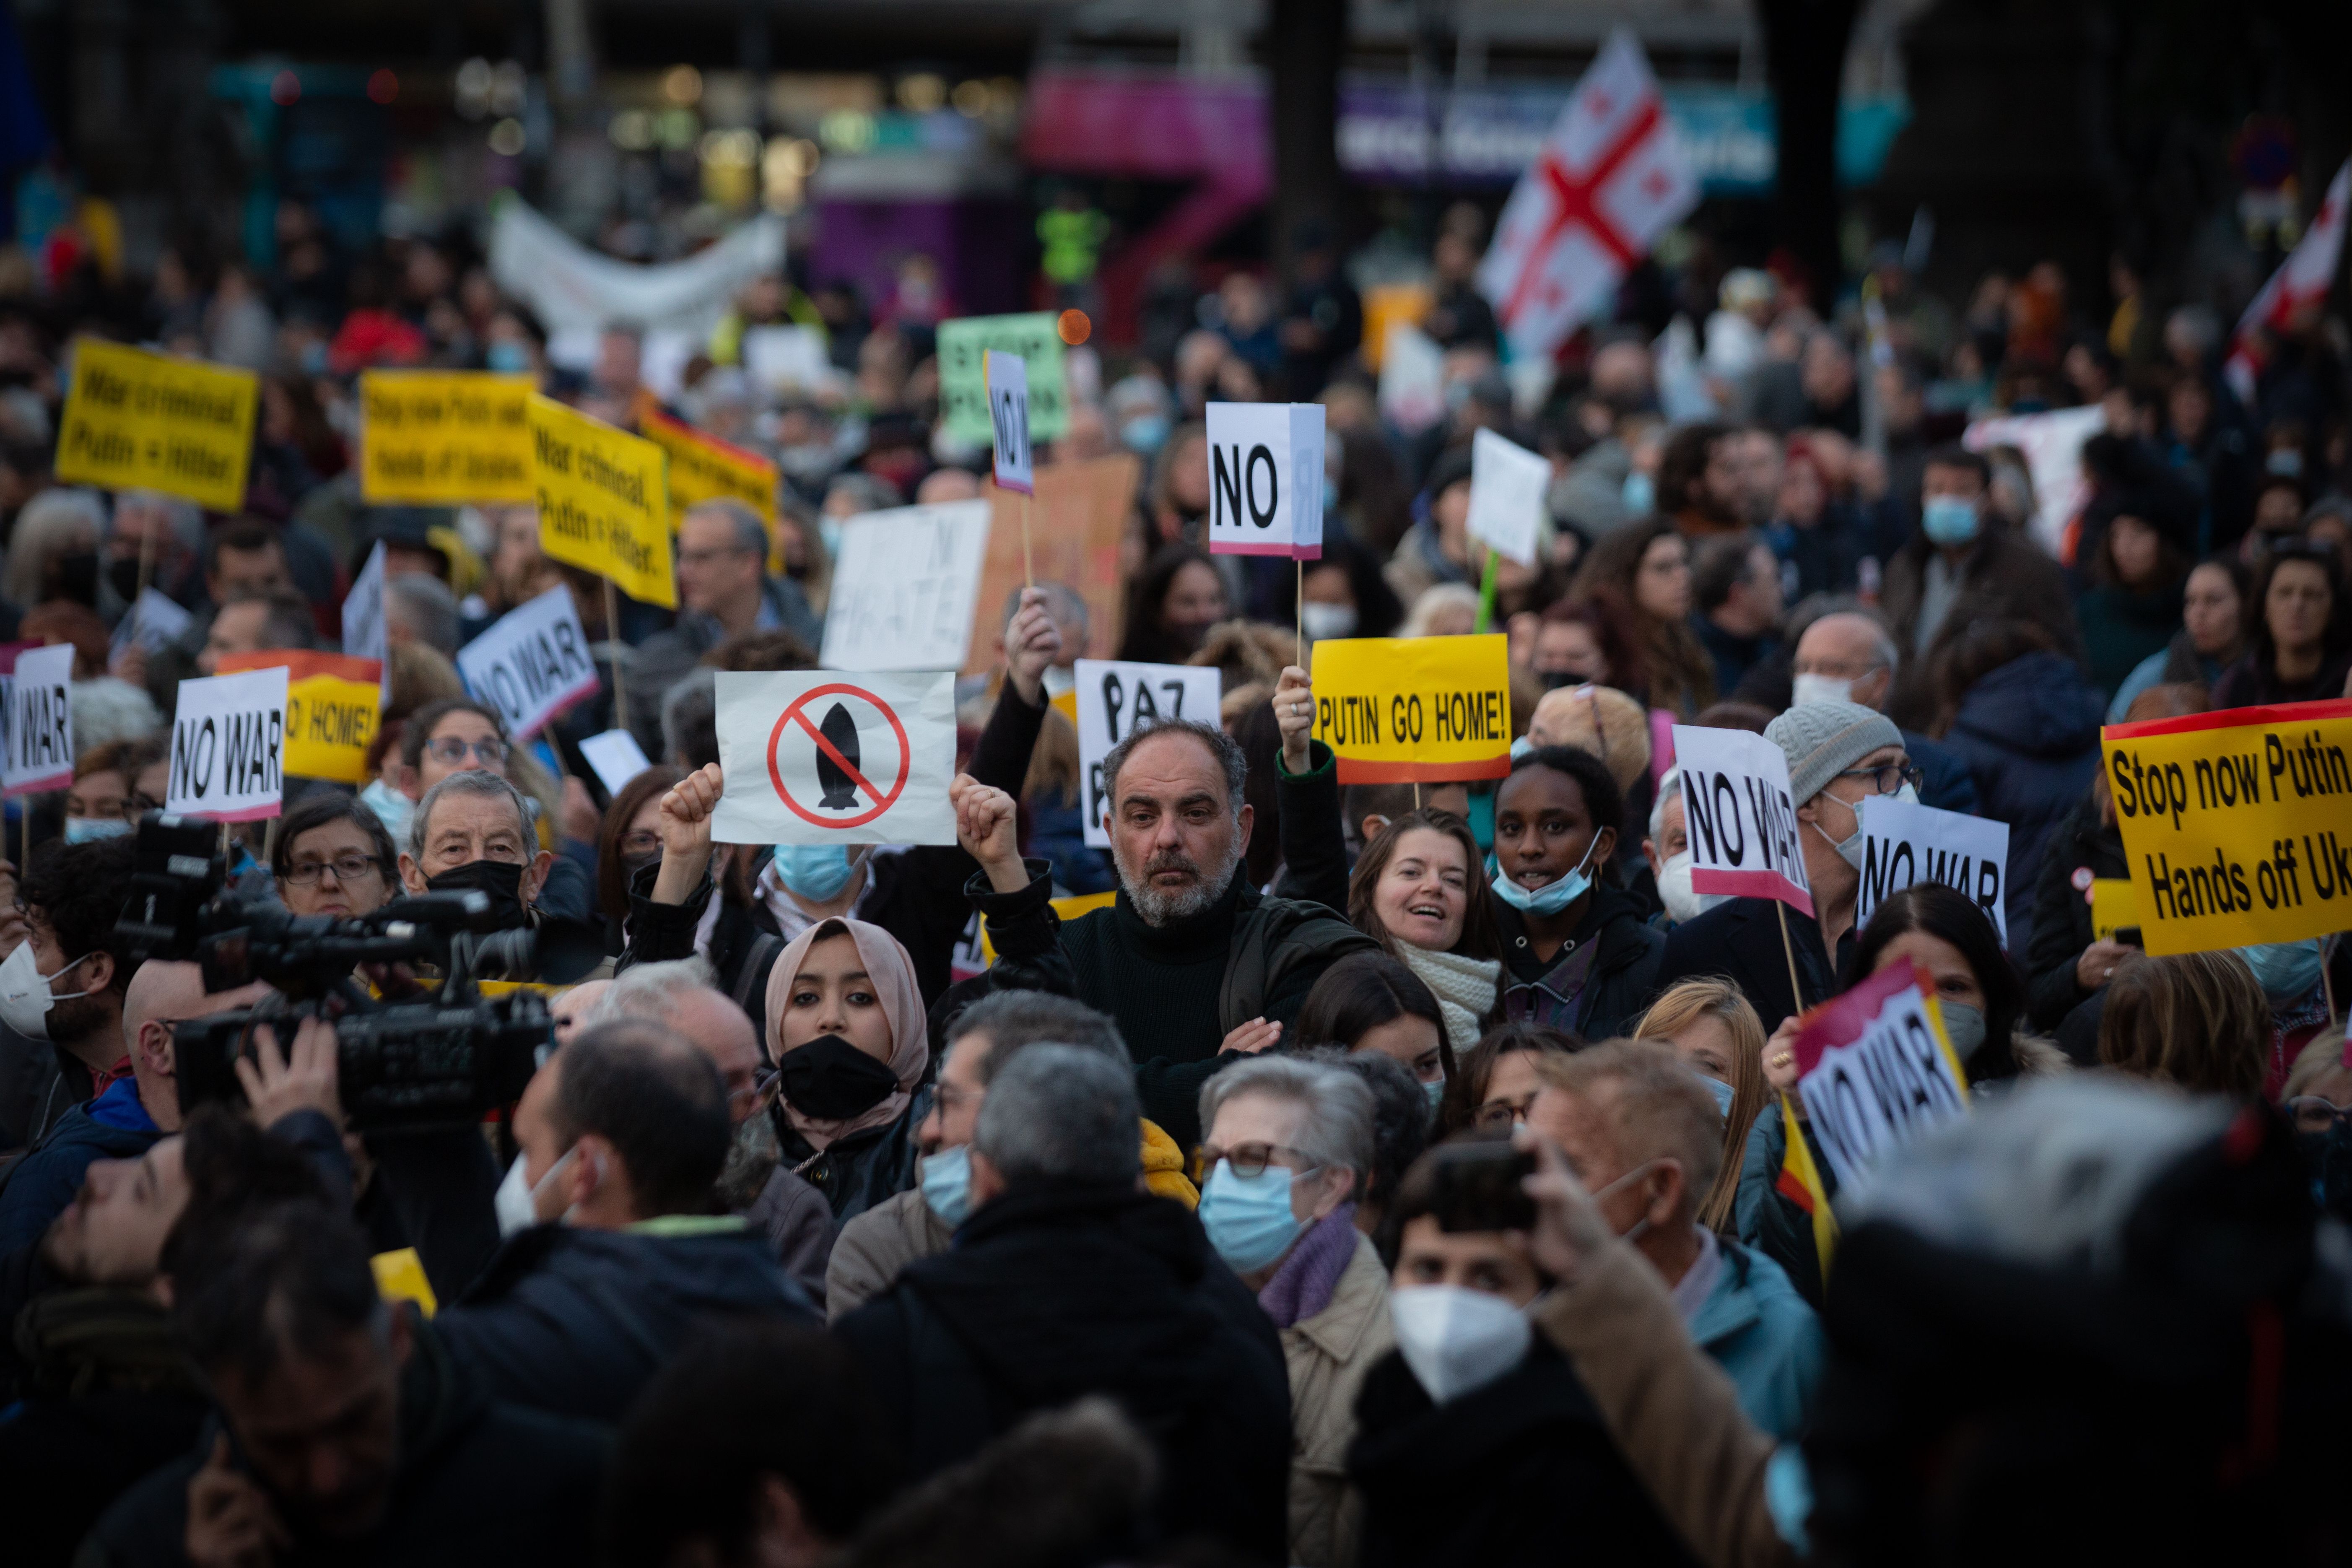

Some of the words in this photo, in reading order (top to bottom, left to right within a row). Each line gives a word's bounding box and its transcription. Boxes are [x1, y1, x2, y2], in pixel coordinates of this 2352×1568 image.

[536, 424, 572, 475] War
[1213, 443, 1277, 528] NO
[537, 485, 589, 543] Putin
[508, 618, 587, 705] WAR
[21, 683, 70, 768] WAR
[169, 715, 215, 800] NO
[223, 708, 281, 795] WAR
[286, 697, 300, 740] O
[309, 699, 372, 749] HOME!
[1320, 695, 1380, 745] PUTIN
[1392, 694, 1423, 743] GO
[1436, 690, 1505, 741] HOME!
[2112, 749, 2187, 831] Stop
[2193, 753, 2261, 810] now
[2265, 729, 2352, 801] Putin
[1682, 770, 1744, 867] NO
[1744, 775, 1807, 890] WAR
[1862, 835, 1914, 916] NO
[2145, 846, 2252, 920] Hands
[2256, 838, 2302, 910] off
[2303, 831, 2352, 900] Uk
[1856, 1011, 1960, 1128] WAR
